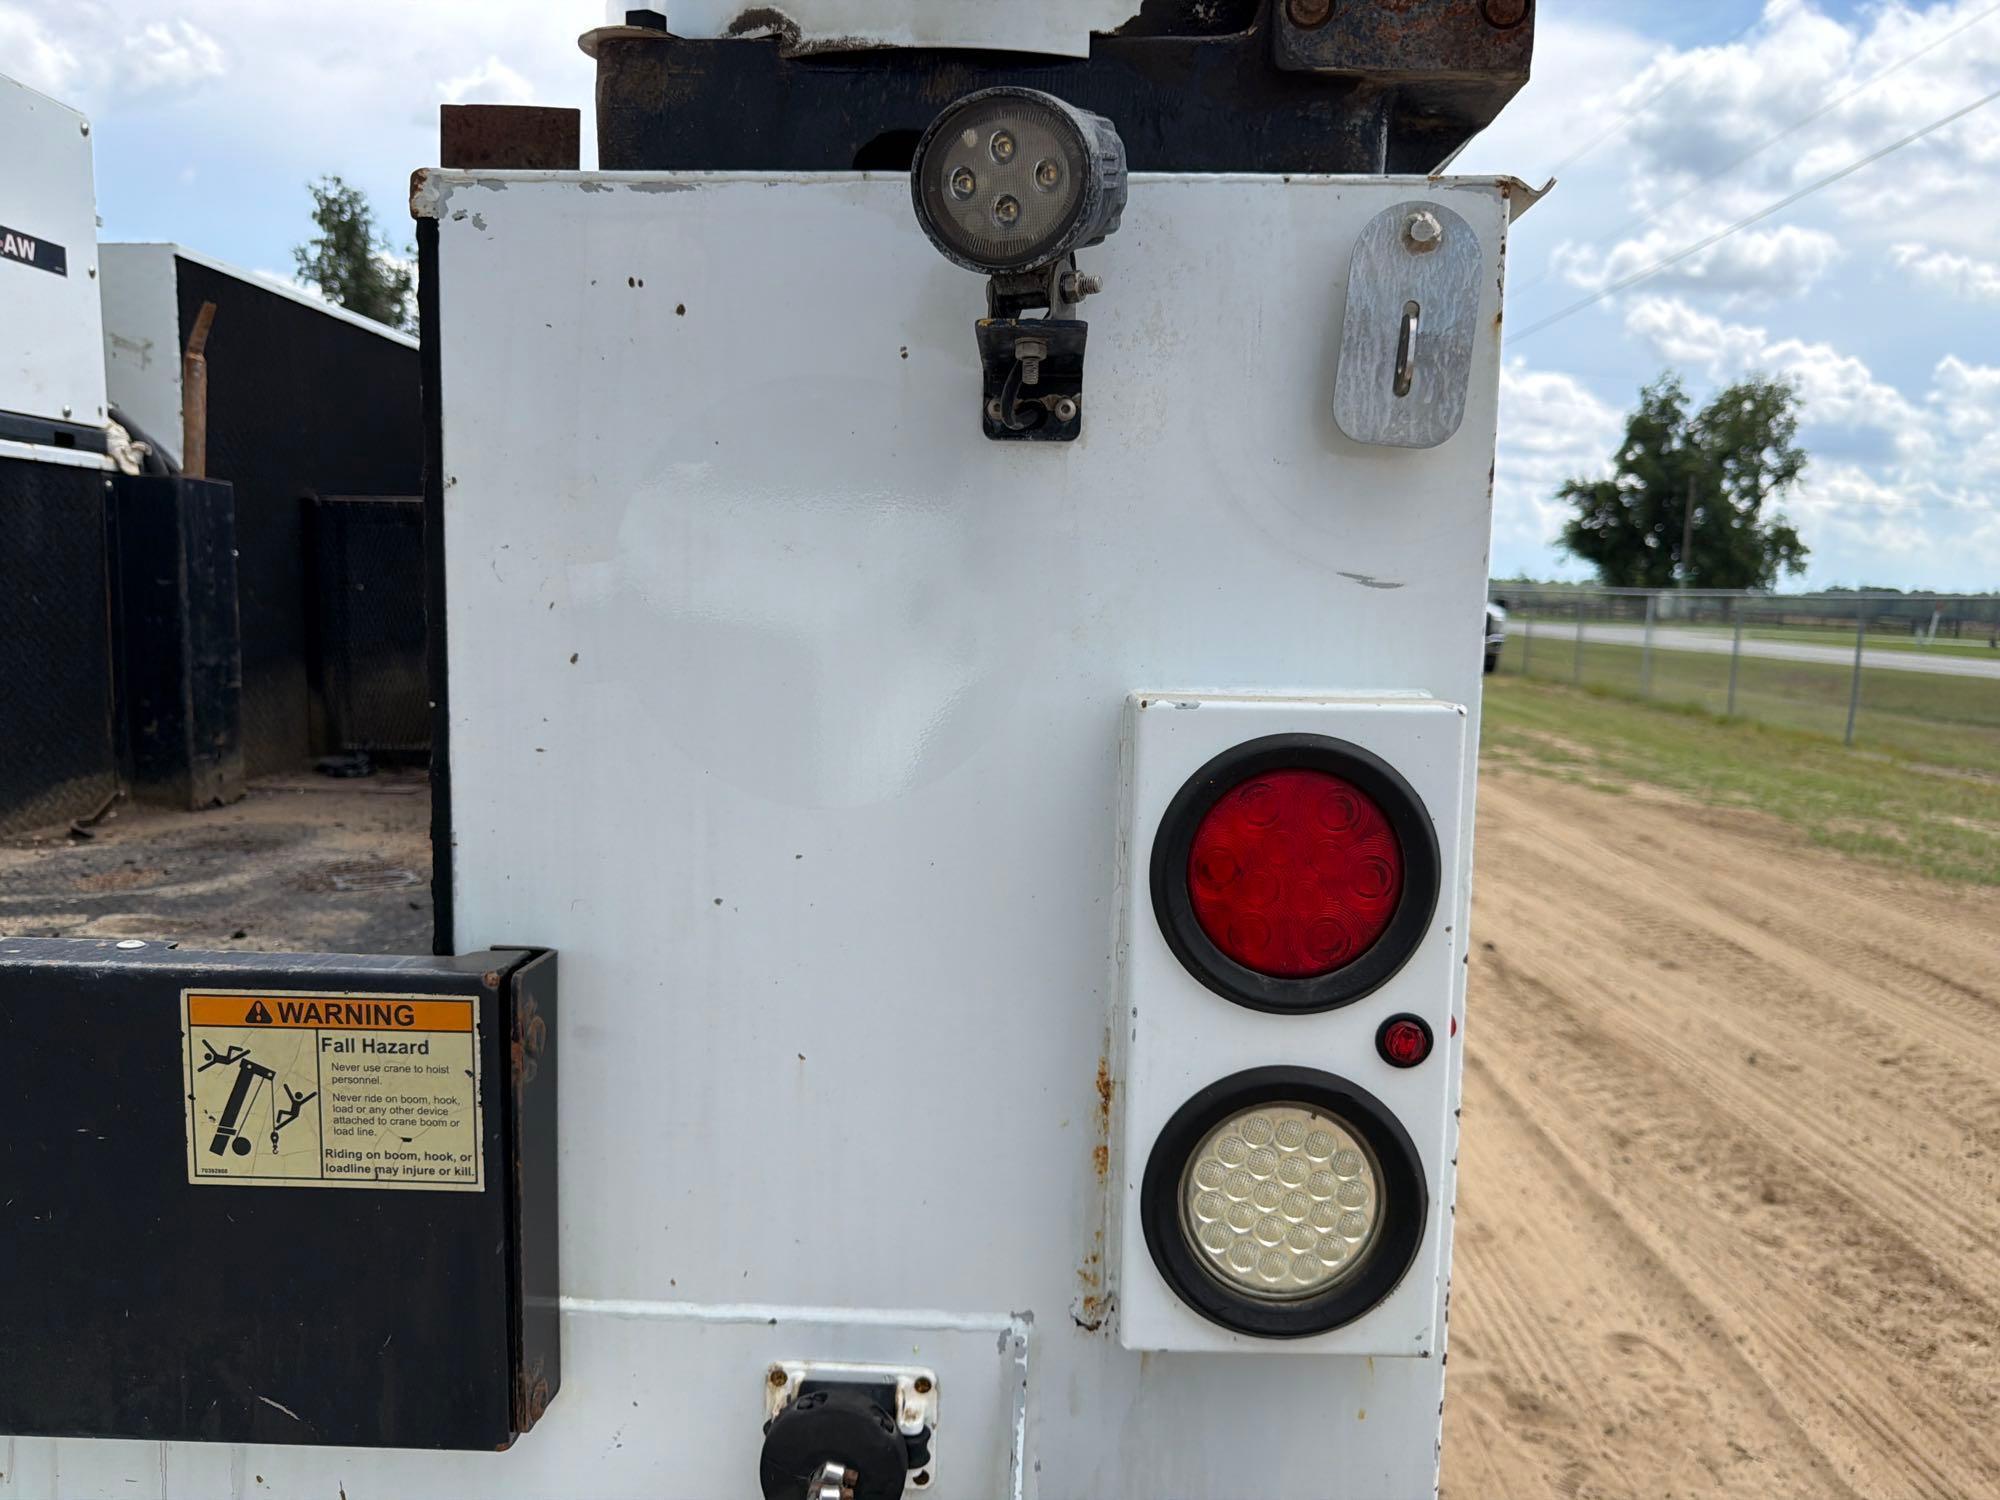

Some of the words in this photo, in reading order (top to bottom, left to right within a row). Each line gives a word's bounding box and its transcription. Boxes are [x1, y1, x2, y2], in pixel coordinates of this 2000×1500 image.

[278, 1002, 415, 1026] WARNING
[322, 1038, 356, 1053] Fall
[363, 1038, 429, 1054] Hazard
[332, 1063, 360, 1072] Never
[363, 1065, 381, 1073] use
[384, 1065, 411, 1073] crane
[414, 1064, 423, 1073] to
[426, 1064, 449, 1074] hoist
[332, 1075, 382, 1086] personnel.
[333, 1094, 361, 1103] Never
[364, 1094, 383, 1103] ride
[400, 1095, 431, 1105] boom,
[433, 1095, 460, 1105] hook,
[333, 1105, 353, 1114] load
[369, 1107, 387, 1117] any
[390, 1106, 415, 1115] other
[417, 1106, 448, 1116] device
[333, 1115, 375, 1125] attached
[377, 1117, 387, 1125] to
[390, 1118, 417, 1126] crane
[420, 1117, 447, 1126] boom
[450, 1119, 460, 1127] or
[334, 1126, 354, 1135] load
[357, 1126, 376, 1136] line.
[325, 1149, 363, 1161] Riding
[366, 1151, 381, 1160] on
[384, 1151, 421, 1162] boom,
[424, 1151, 457, 1163] hook,
[460, 1153, 472, 1161] or
[326, 1164, 371, 1174] loadline
[374, 1166, 399, 1178] may
[402, 1165, 436, 1178] injure
[455, 1165, 474, 1176] kill.
